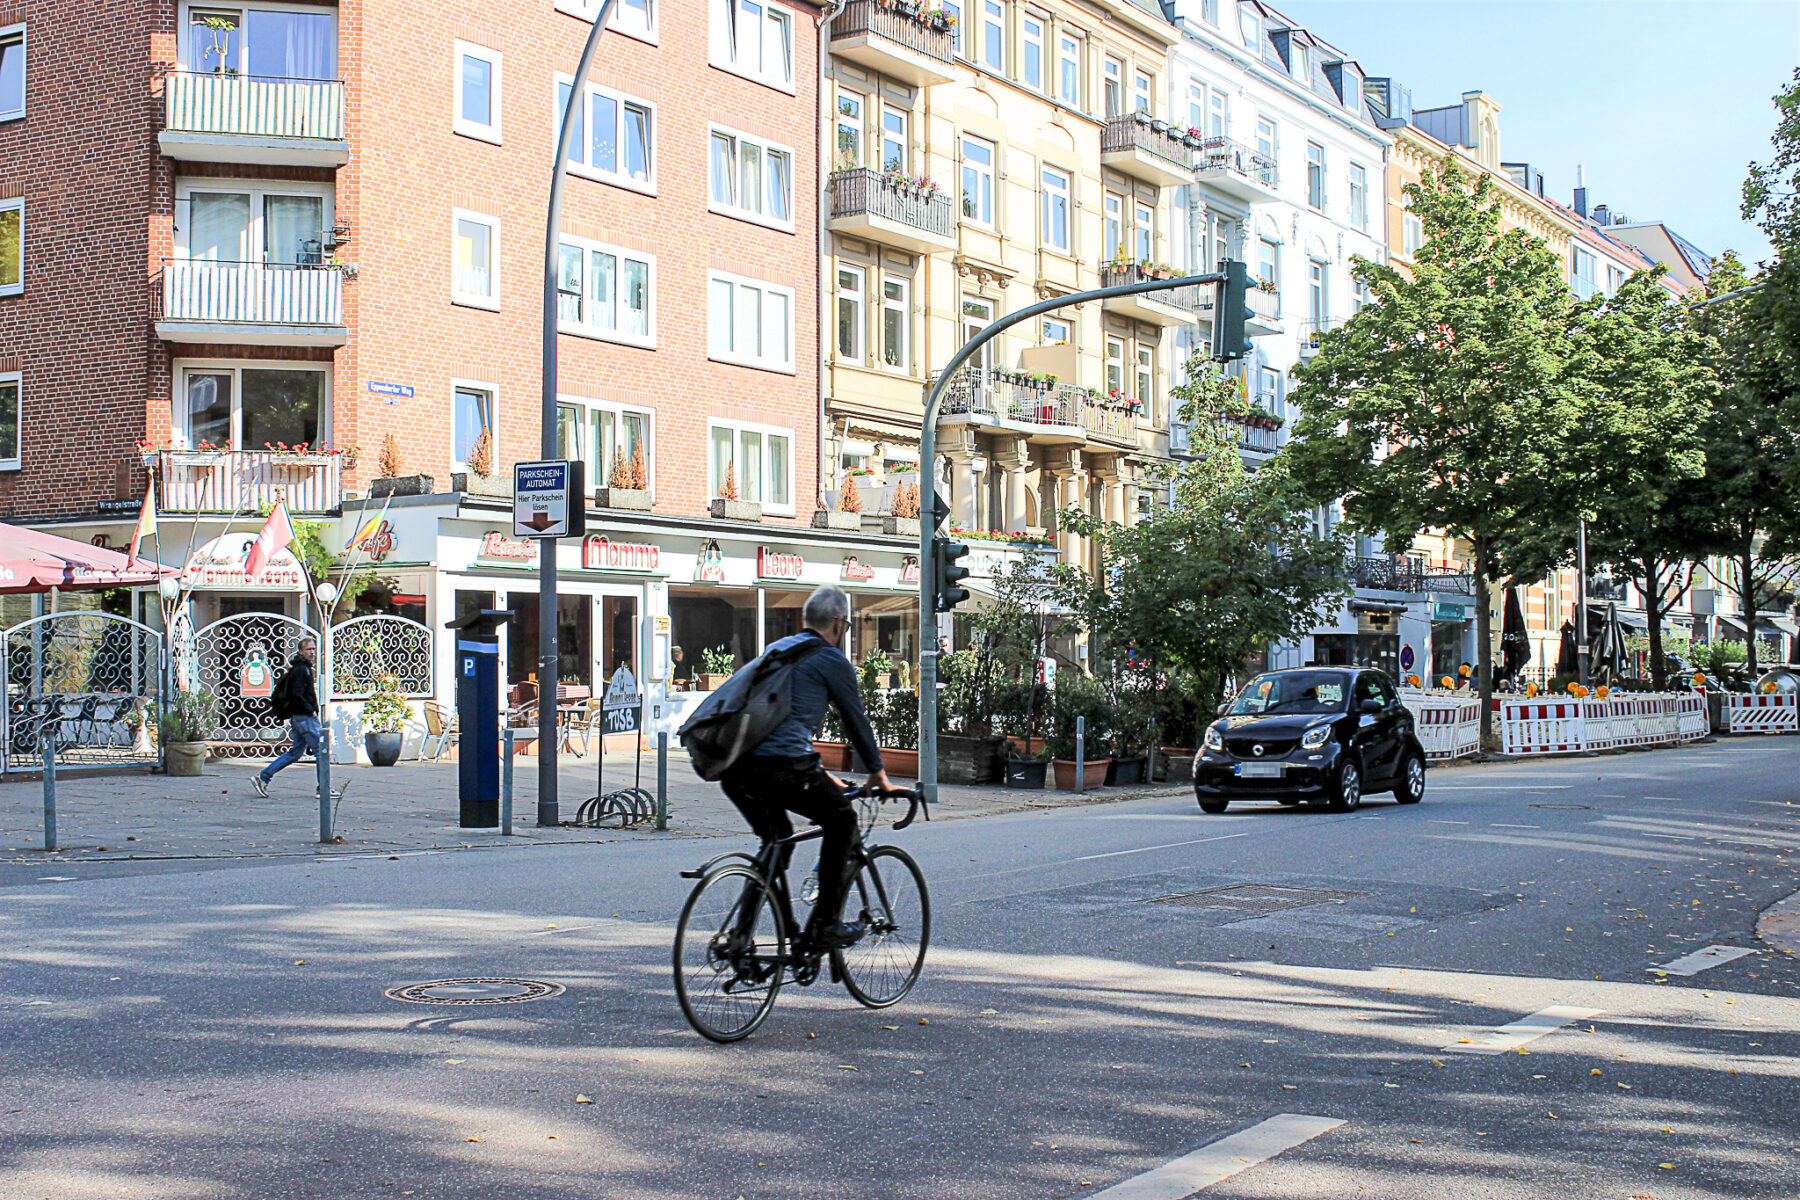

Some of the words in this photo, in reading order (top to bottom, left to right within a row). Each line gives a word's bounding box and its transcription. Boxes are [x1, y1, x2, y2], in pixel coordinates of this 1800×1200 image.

[401, 386, 412, 397] Weg
[519, 468, 564, 479] PARKSCHEIN-
[525, 478, 556, 488] AUTOMAT
[518, 494, 531, 502] Hier
[531, 493, 564, 502] Parkschein
[99, 499, 143, 510] Wrangelstraße
[532, 503, 549, 511] lösen
[591, 535, 659, 569] Mamma
[764, 546, 804, 578] Leone
[464, 658, 474, 675] P
